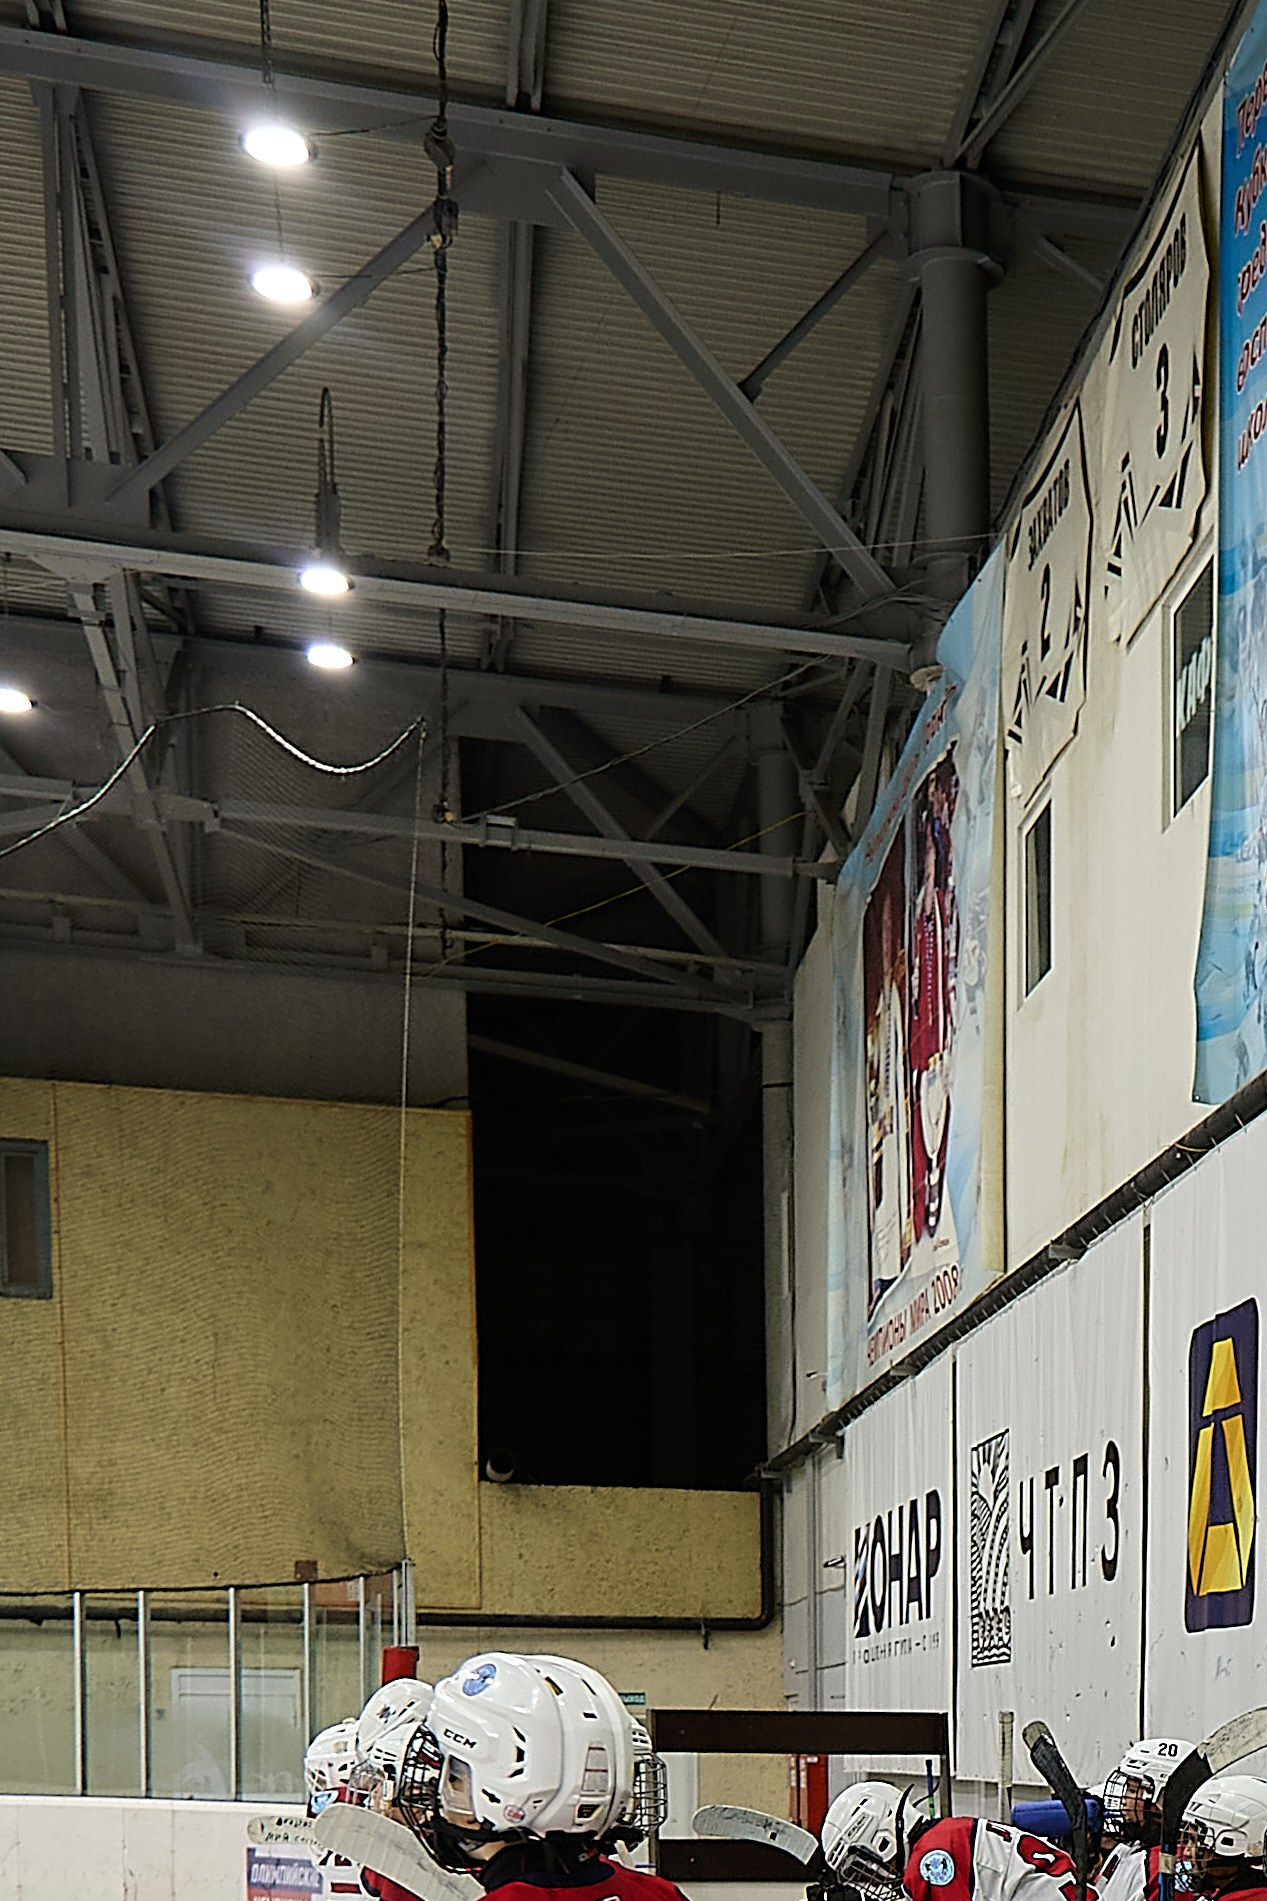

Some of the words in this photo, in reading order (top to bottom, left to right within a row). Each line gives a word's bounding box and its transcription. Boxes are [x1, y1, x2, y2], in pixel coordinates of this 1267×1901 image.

[1155, 341, 1170, 460] 3
[1041, 562, 1052, 663] 2
[1019, 1440, 1120, 1600] ЧТПЗ
[443, 1727, 478, 1749] CCM
[1157, 1741, 1179, 1758] 20
